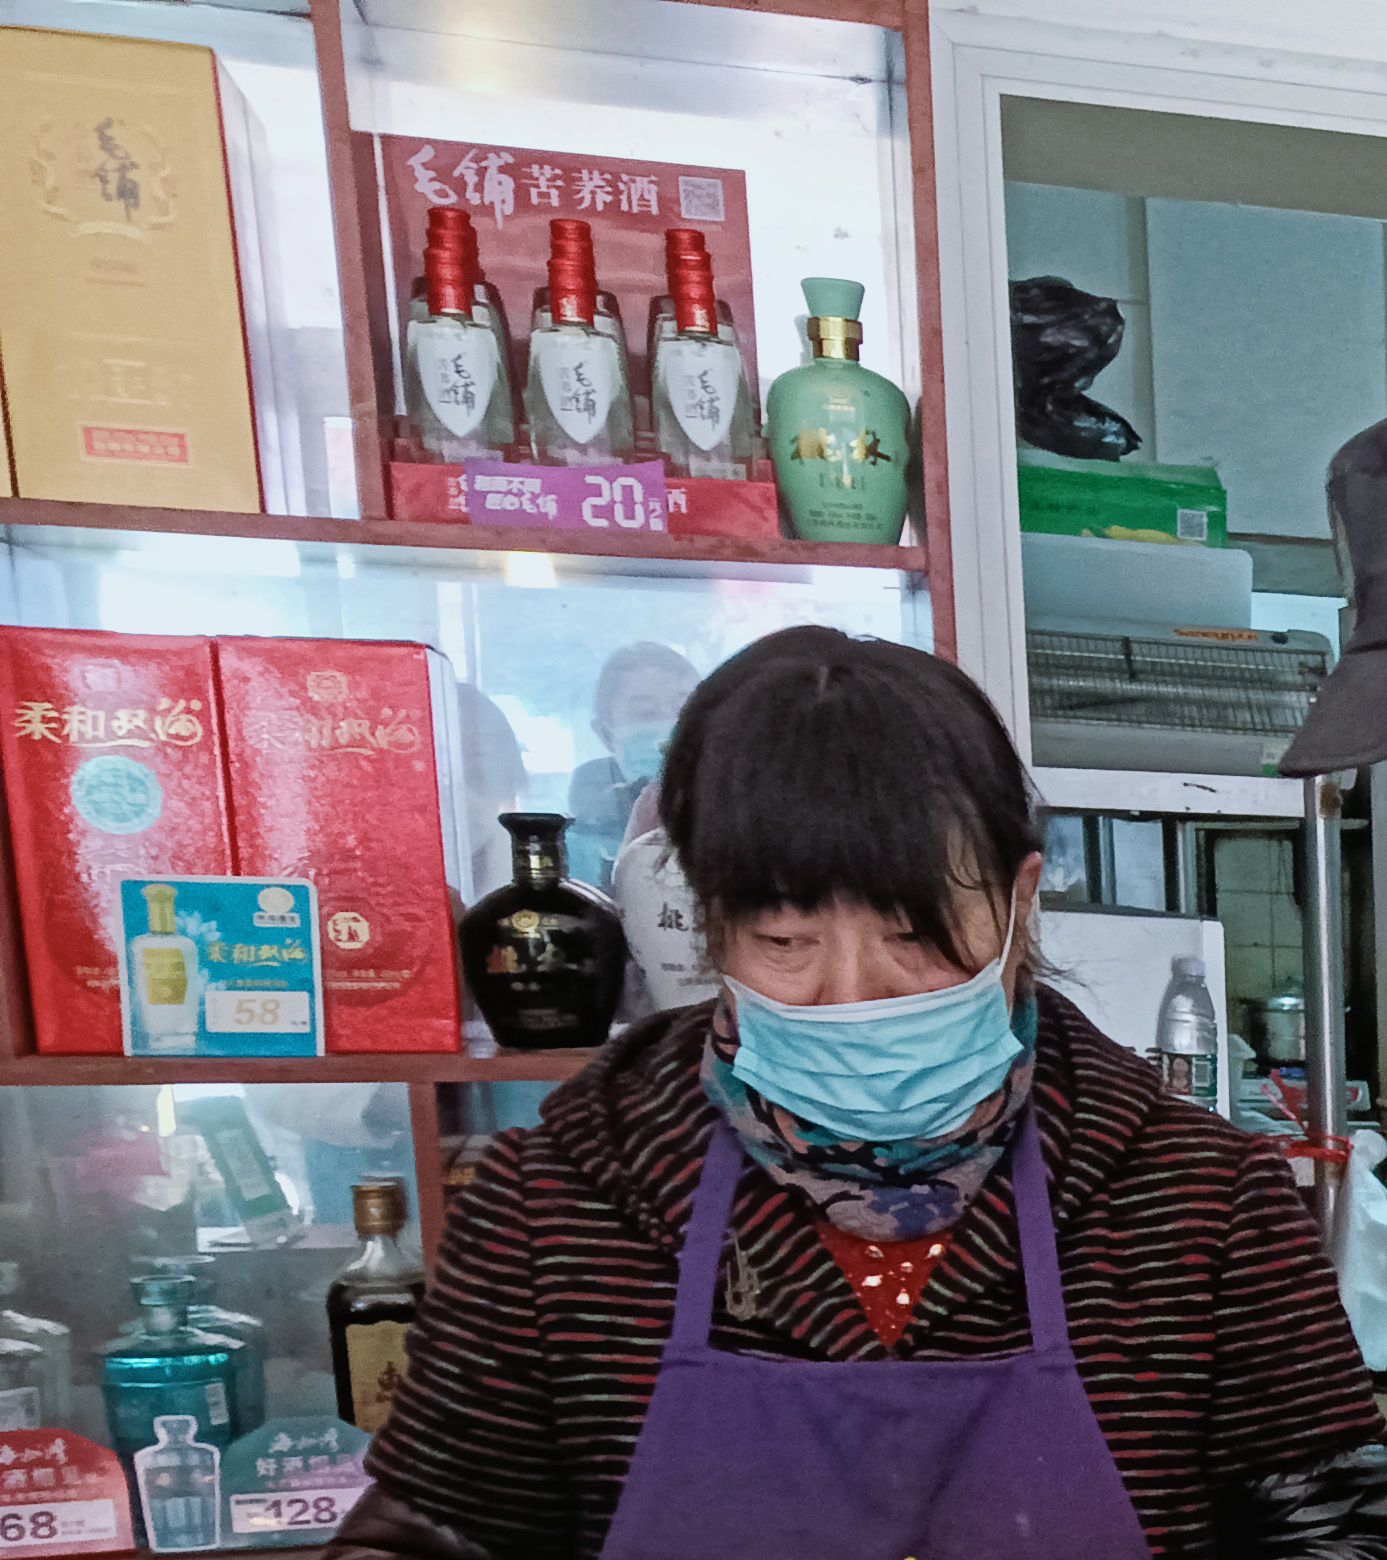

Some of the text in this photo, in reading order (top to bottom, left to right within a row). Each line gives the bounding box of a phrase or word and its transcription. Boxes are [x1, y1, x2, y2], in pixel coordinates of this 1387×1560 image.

[408, 145, 659, 228] 毛铺苦荞酒
[583, 475, 645, 528] 20
[234, 998, 282, 1026] 58
[264, 1497, 338, 1525] 128
